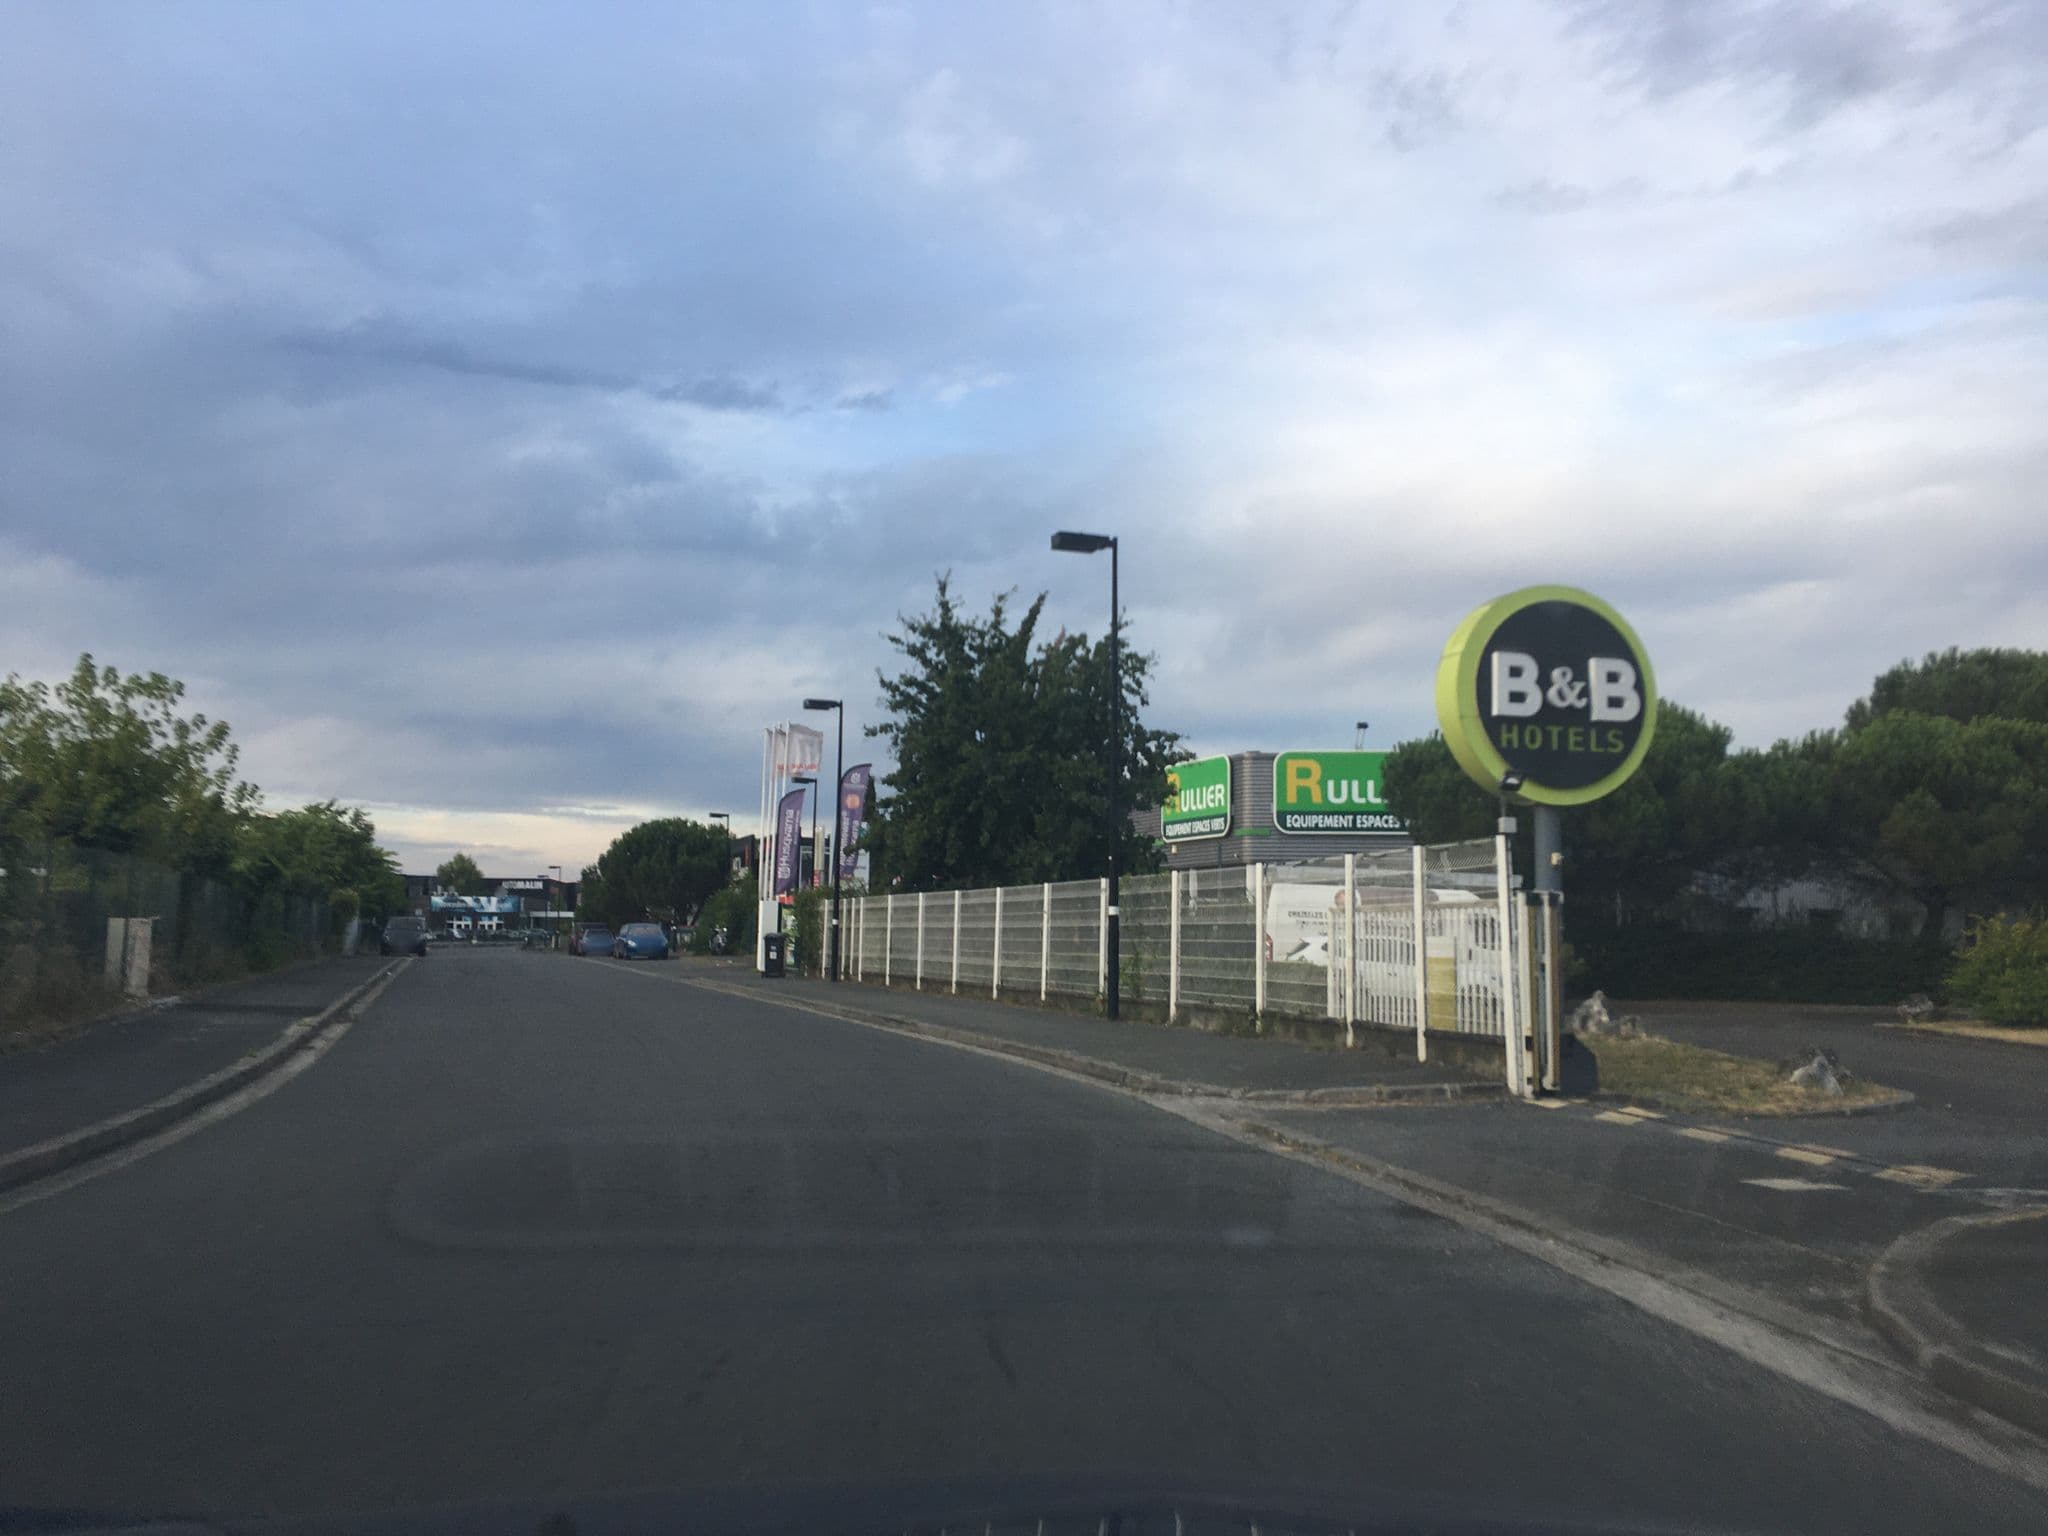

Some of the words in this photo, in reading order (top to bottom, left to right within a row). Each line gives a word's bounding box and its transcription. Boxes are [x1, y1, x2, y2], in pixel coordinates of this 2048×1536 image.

[1491, 650, 1641, 722] B&B
[1500, 723, 1625, 753] HOTELS
[1286, 759, 1388, 804] RULL
[1286, 814, 1353, 828] EQUIPEMENT
[1356, 814, 1400, 828] ESPACES
